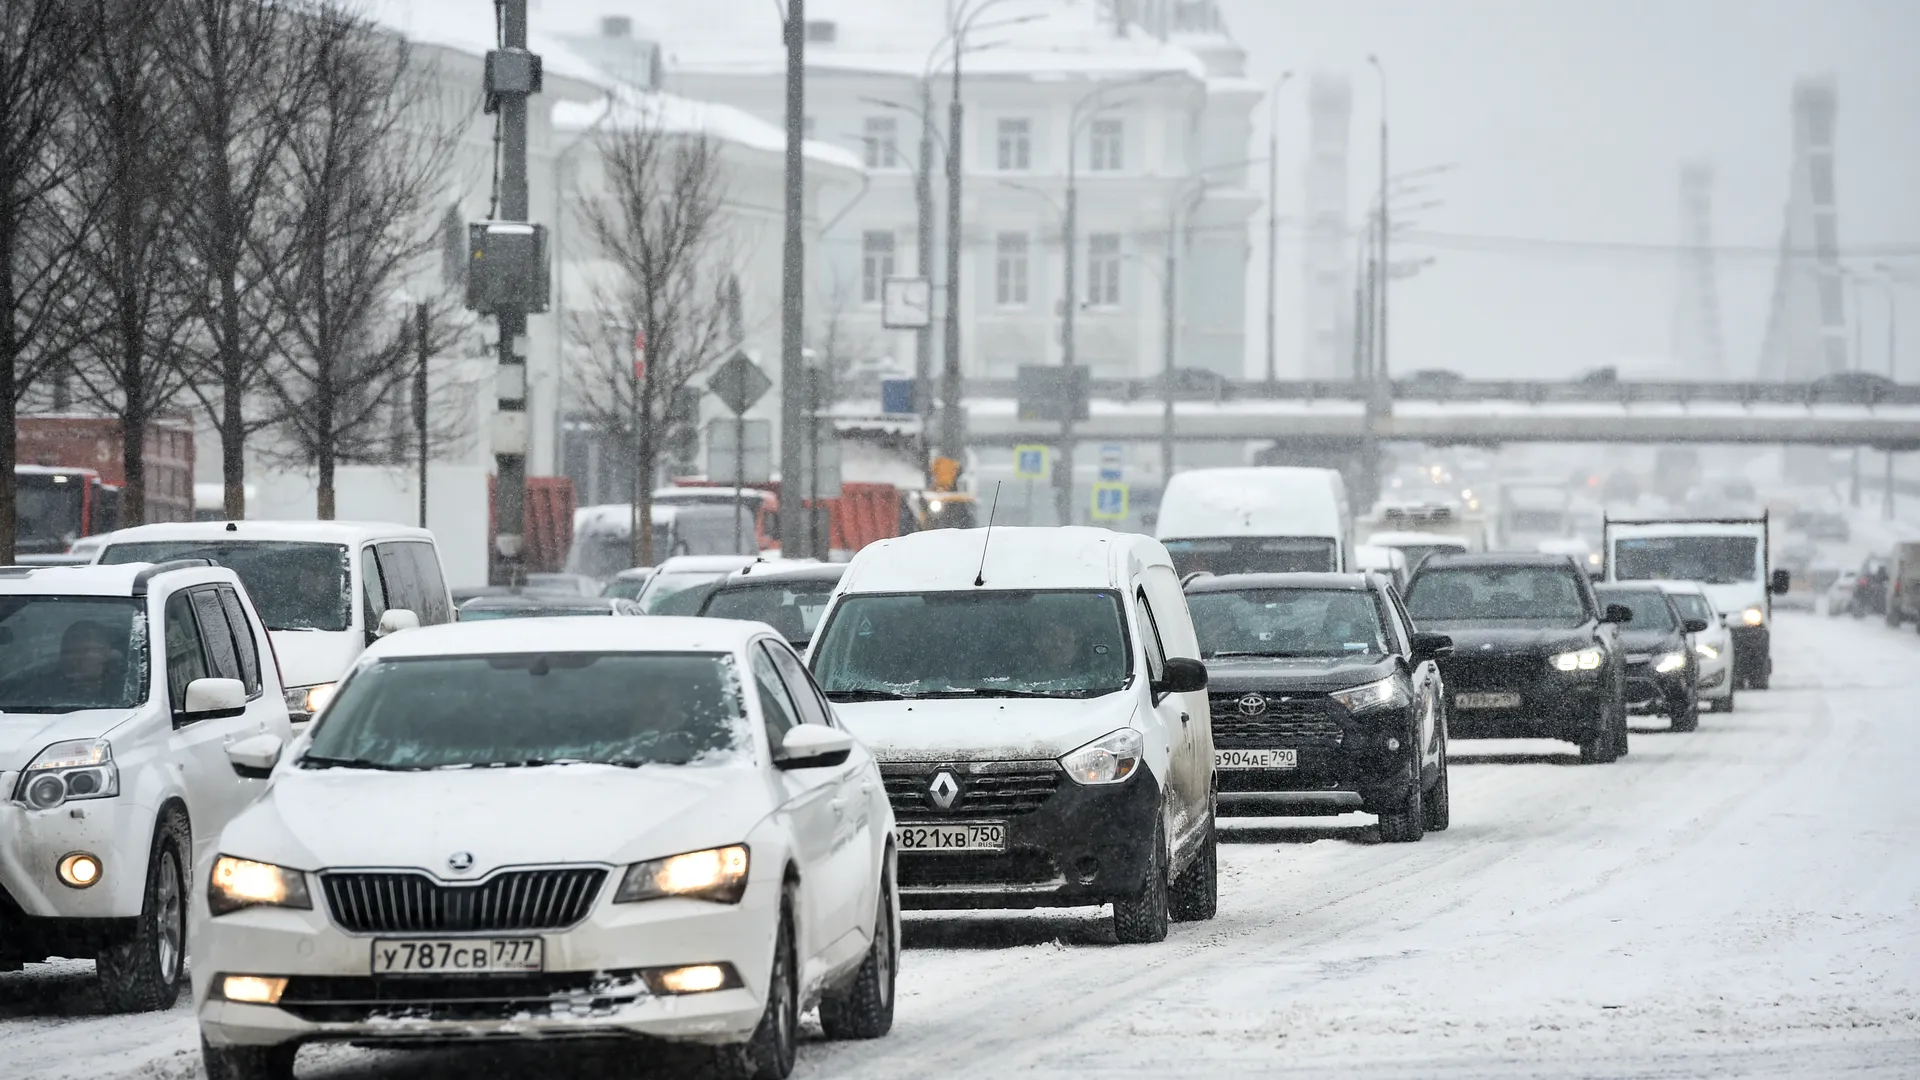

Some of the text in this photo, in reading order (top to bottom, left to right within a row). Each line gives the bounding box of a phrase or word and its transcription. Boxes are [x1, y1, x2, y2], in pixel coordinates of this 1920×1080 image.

[1272, 751, 1293, 761] 790
[970, 827, 1000, 841] 750
[383, 941, 534, 970] У787СВ 777
